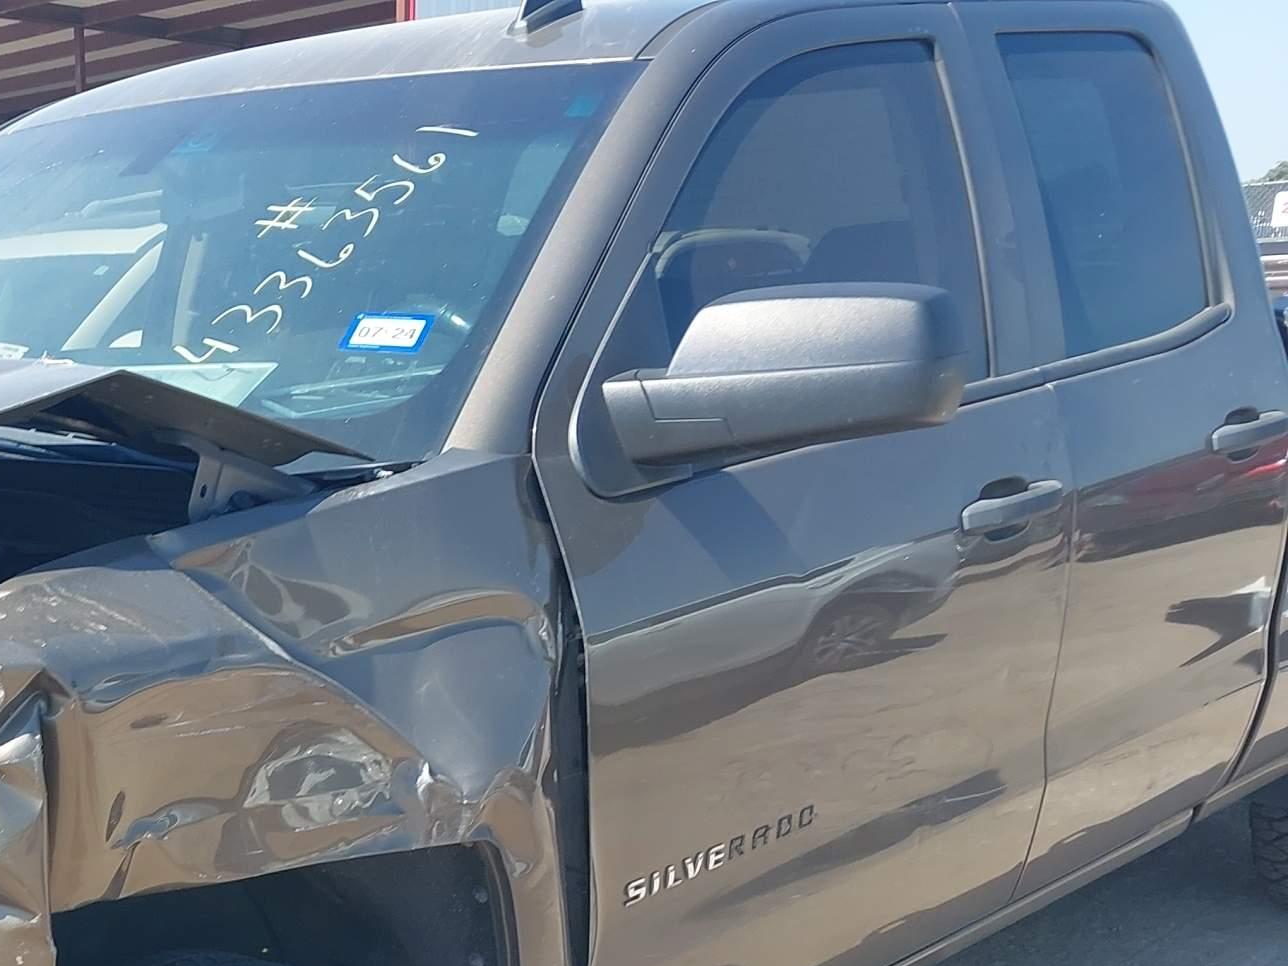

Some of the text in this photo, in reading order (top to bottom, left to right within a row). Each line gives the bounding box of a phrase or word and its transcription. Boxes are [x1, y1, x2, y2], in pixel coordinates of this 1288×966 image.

[173, 126, 480, 364] 43363561
[255, 196, 318, 238] #
[623, 804, 818, 907] SILVERADO
